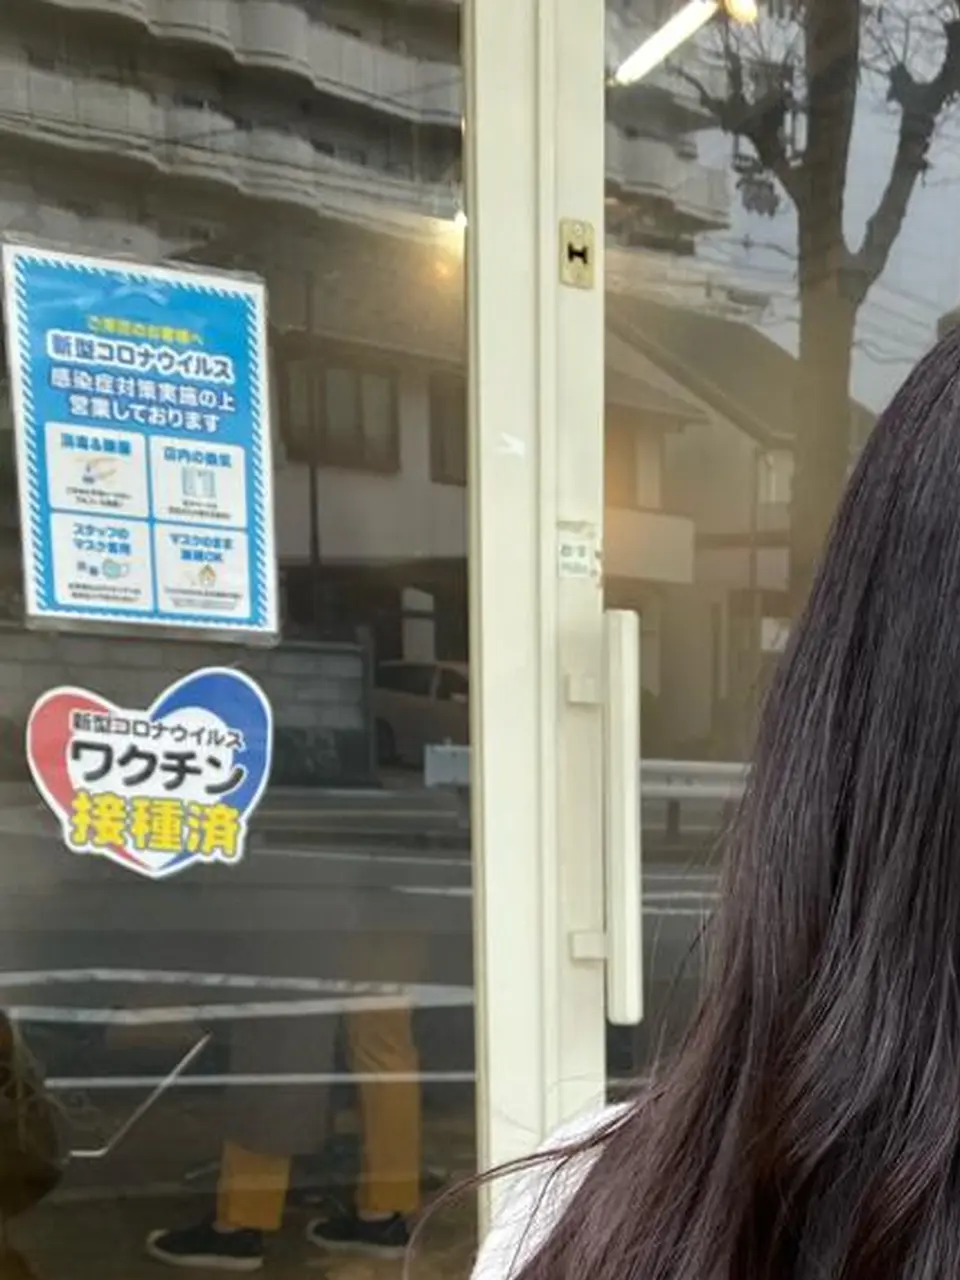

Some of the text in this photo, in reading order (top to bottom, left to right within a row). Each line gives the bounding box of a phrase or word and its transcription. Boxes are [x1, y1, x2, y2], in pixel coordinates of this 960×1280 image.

[50, 332, 232, 381] 新型コロナウイルス
[69, 393, 220, 433] 営業しております
[72, 711, 244, 749] 新型コロナウイルス
[71, 740, 244, 794] ワクチン
[71, 791, 241, 857] 接種済
